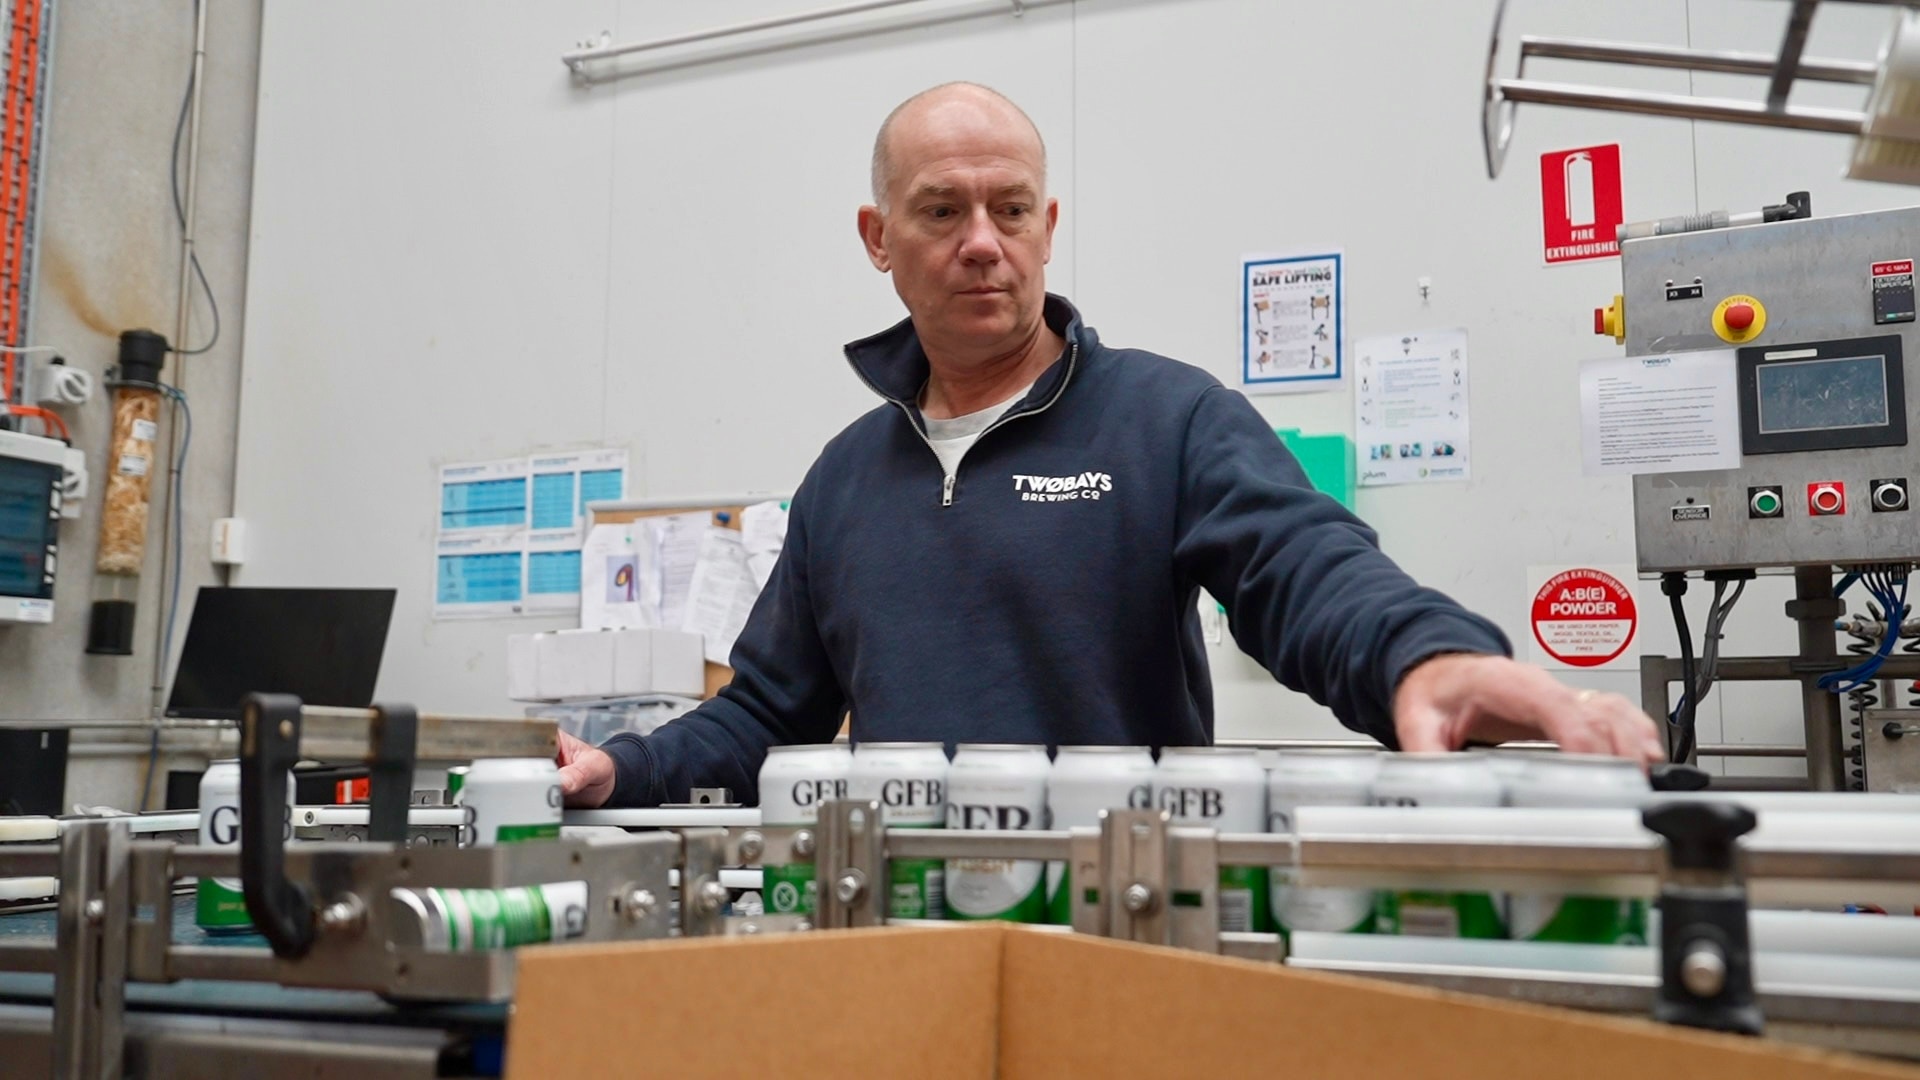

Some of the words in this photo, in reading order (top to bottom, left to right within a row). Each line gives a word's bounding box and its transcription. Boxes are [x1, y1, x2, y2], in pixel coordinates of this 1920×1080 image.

[1571, 228, 1595, 241] FIRE
[1253, 275, 1280, 287] SAFE
[1285, 271, 1332, 284] LIFTING
[1021, 491, 1079, 502] BREWING
[1537, 583, 1553, 600] THIS
[1551, 572, 1570, 587] FIRE
[1571, 570, 1629, 600] EXTINGUISHER
[1560, 586, 1606, 601] A:B(E)
[1550, 602, 1617, 616] POWDER
[882, 778, 942, 807] GFB
[1159, 786, 1223, 818] GFB
